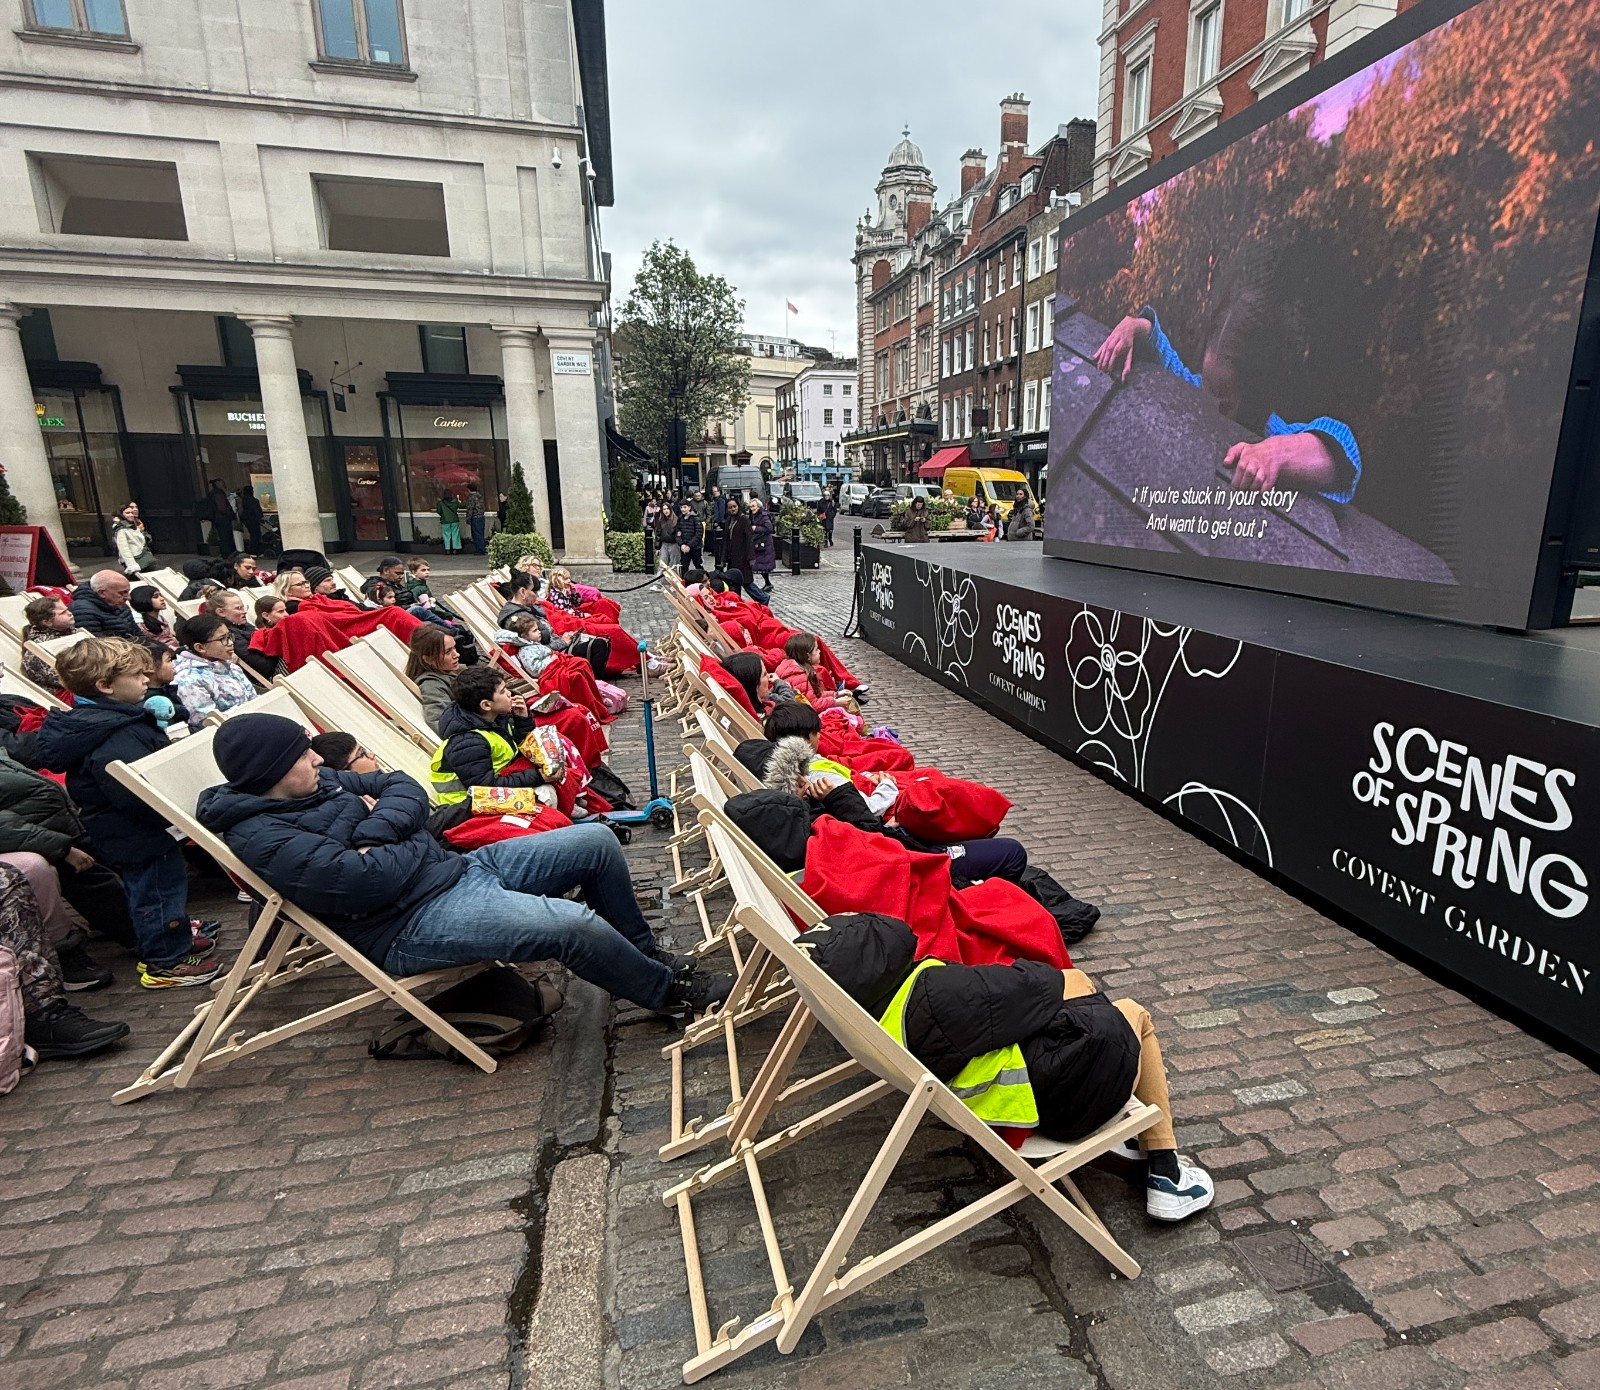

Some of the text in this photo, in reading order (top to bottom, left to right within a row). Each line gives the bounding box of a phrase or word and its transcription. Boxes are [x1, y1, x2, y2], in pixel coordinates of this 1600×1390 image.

[37, 416, 65, 427] LEX
[433, 416, 469, 428] Cartier
[357, 477, 378, 485] Cartier
[1140, 486, 1299, 513] If you're stuck in your story
[1146, 513, 1257, 540] And want to get out
[871, 562, 892, 587] SCENES
[996, 603, 1042, 644] SCENES
[992, 630, 1046, 681] OF SPRING
[988, 672, 1047, 712] COVENT GARDEN
[1368, 721, 1576, 832] SCENES
[1352, 771, 1590, 919] OF SPRING
[1331, 848, 1592, 996] COVENT GARDEN
